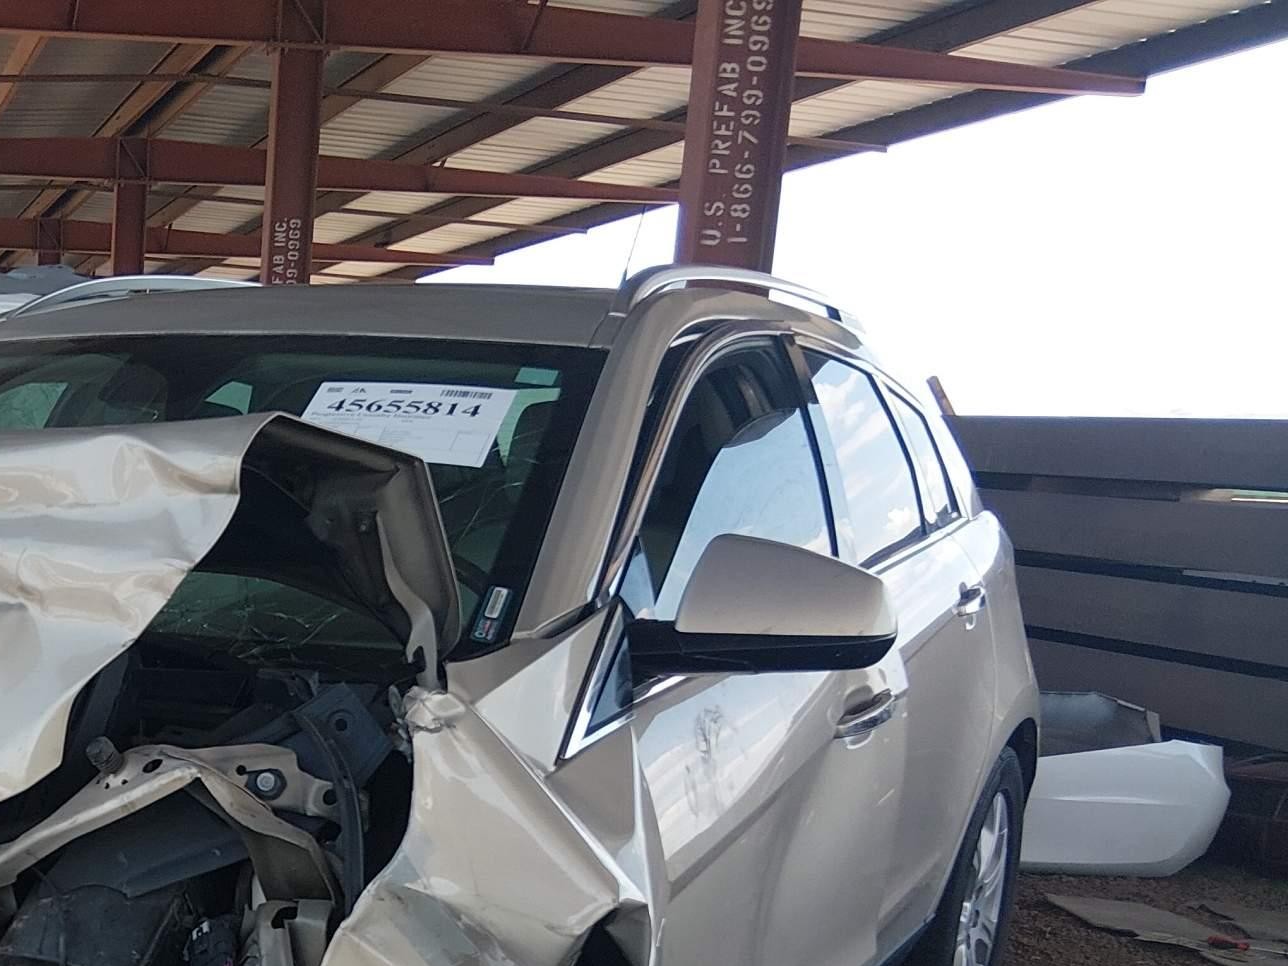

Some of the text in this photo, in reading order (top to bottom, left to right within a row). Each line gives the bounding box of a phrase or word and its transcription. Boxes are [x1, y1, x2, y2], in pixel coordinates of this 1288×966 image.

[708, 62, 741, 174] PREFAB
[274, 217, 287, 247] INC.
[327, 399, 482, 417] 45655814
